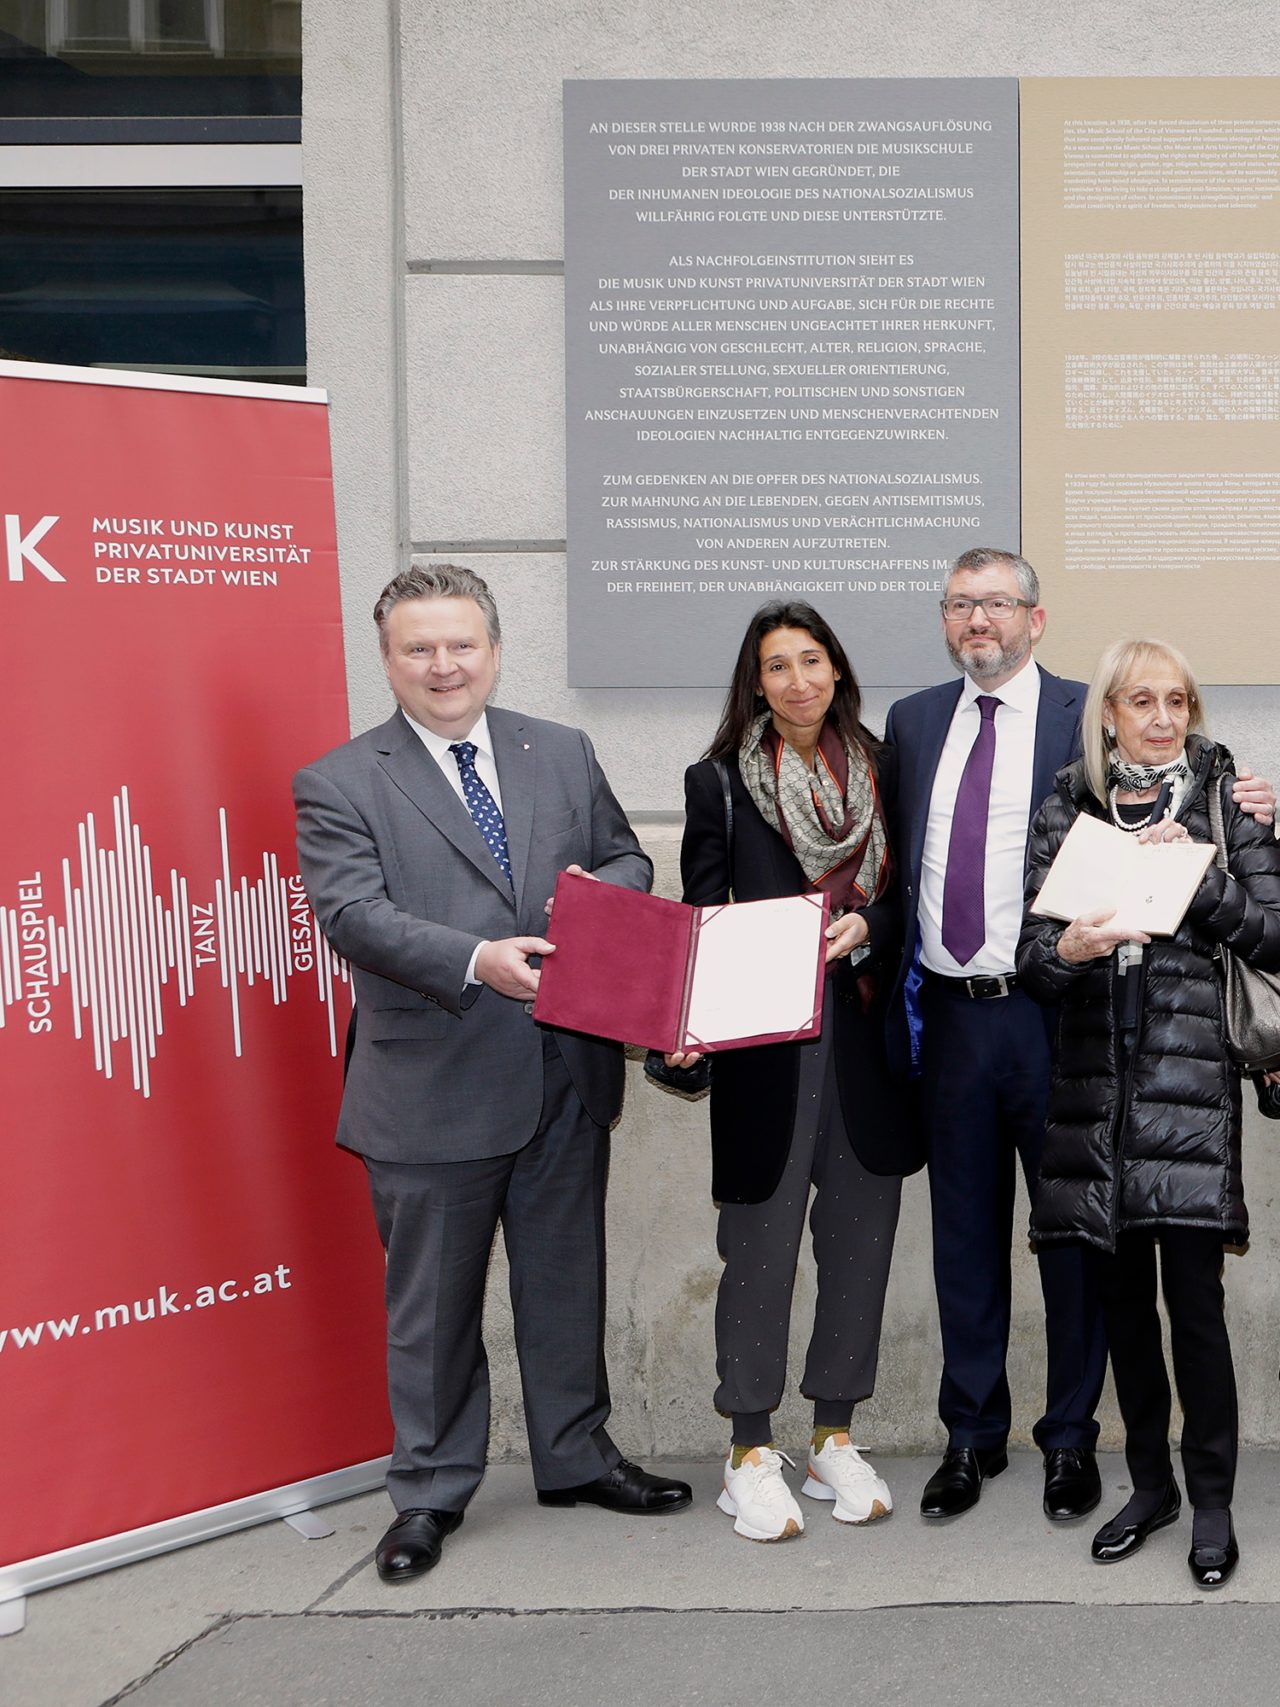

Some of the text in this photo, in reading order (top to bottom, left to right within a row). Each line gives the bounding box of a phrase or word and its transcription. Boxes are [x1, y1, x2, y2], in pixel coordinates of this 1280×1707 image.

[589, 118, 992, 134] AN DIESER STELLE WURDE 1938 NACH DER ZWANGSAUFLÖSUNG
[608, 142, 974, 156] VON DREI PRIVATEN KONSERVATORIEN DIE MUSIKSCHULE
[681, 163, 901, 178] DER STADT WIEN GEGRÜNDET, DIE
[608, 187, 974, 201] DER INHUMANEN IDEOLOGIE DES NATIONALSOZIALISMUS
[635, 207, 947, 223] WILLFÄHRIG FOLGTE UND DIESE UNTERSTÜTZTE.
[668, 254, 914, 267] ALS NACHFOLGEINSTITUTION SIEHT ES
[598, 274, 985, 289] DIE MUSIK UND KUNST PRIVATUNIVERSITÄT DER STADT WIEN
[588, 296, 995, 312] ALS IHRE VERPFLICHTUNG UND AUFGABE, SICH FÜR DIE RECHTE
[589, 319, 996, 332] UND WÜRDE ALLER MENSCHEN UNGEACHTET IHRER HERKUNFT,
[598, 341, 986, 355] UNABHÄNGIG VON GESCHLECHT, ALTER, RELIGION, SPRACHE,
[634, 363, 950, 377] SOZIALER STELLUNG, SEXUELLER ORIENTIERUNG,
[618, 385, 965, 399] STAATSBÜRGERSCHAFT, POLITISCHEN UND SONSTIGEN
[584, 408, 999, 421] ANSCHAUUNGEN EINZUSETZEN UND MENSCHENVERACHTENDEN
[636, 429, 949, 441] IDEOLOGIEN NACHHALTIG ENTGEGENZUWIRKEN.
[602, 473, 984, 486] ZUM GEDENKEN AN DIE OPFER DES NATIONALSOZIALISMUS.
[601, 495, 985, 508] ZUR MAHNUNG AN DIE LEBENDEN, GEGEN ANTISEMITISMUS,
[92, 517, 294, 541] MUSIK UND KUNST
[605, 514, 981, 530] RASSISMUS, NATIONALISMUS UND VERÄCHTLICHMACHUNG
[695, 537, 891, 549] VON ANDEREN AUFZUTRETEN.
[94, 542, 311, 564] PRIVATUNIVERSITÄT
[591, 558, 948, 572] ZUR STÄRKUNG DES KUNST- UND KULTURSCHAFFENS IM
[96, 567, 278, 586] DER STADT WIEN
[607, 581, 633, 593] DER
[635, 581, 696, 593] FREIHEIT,
[699, 581, 726, 593] DER
[727, 579, 846, 593] UNABHÄNGIGKEIT
[847, 581, 877, 592] UND
[879, 580, 906, 592] DER
[288, 874, 314, 972] GESANG
[192, 902, 217, 968] TANZ
[18, 871, 52, 1034] SCHAUSPIEL
[0, 1264, 292, 1351] ww.muk.ac.at
